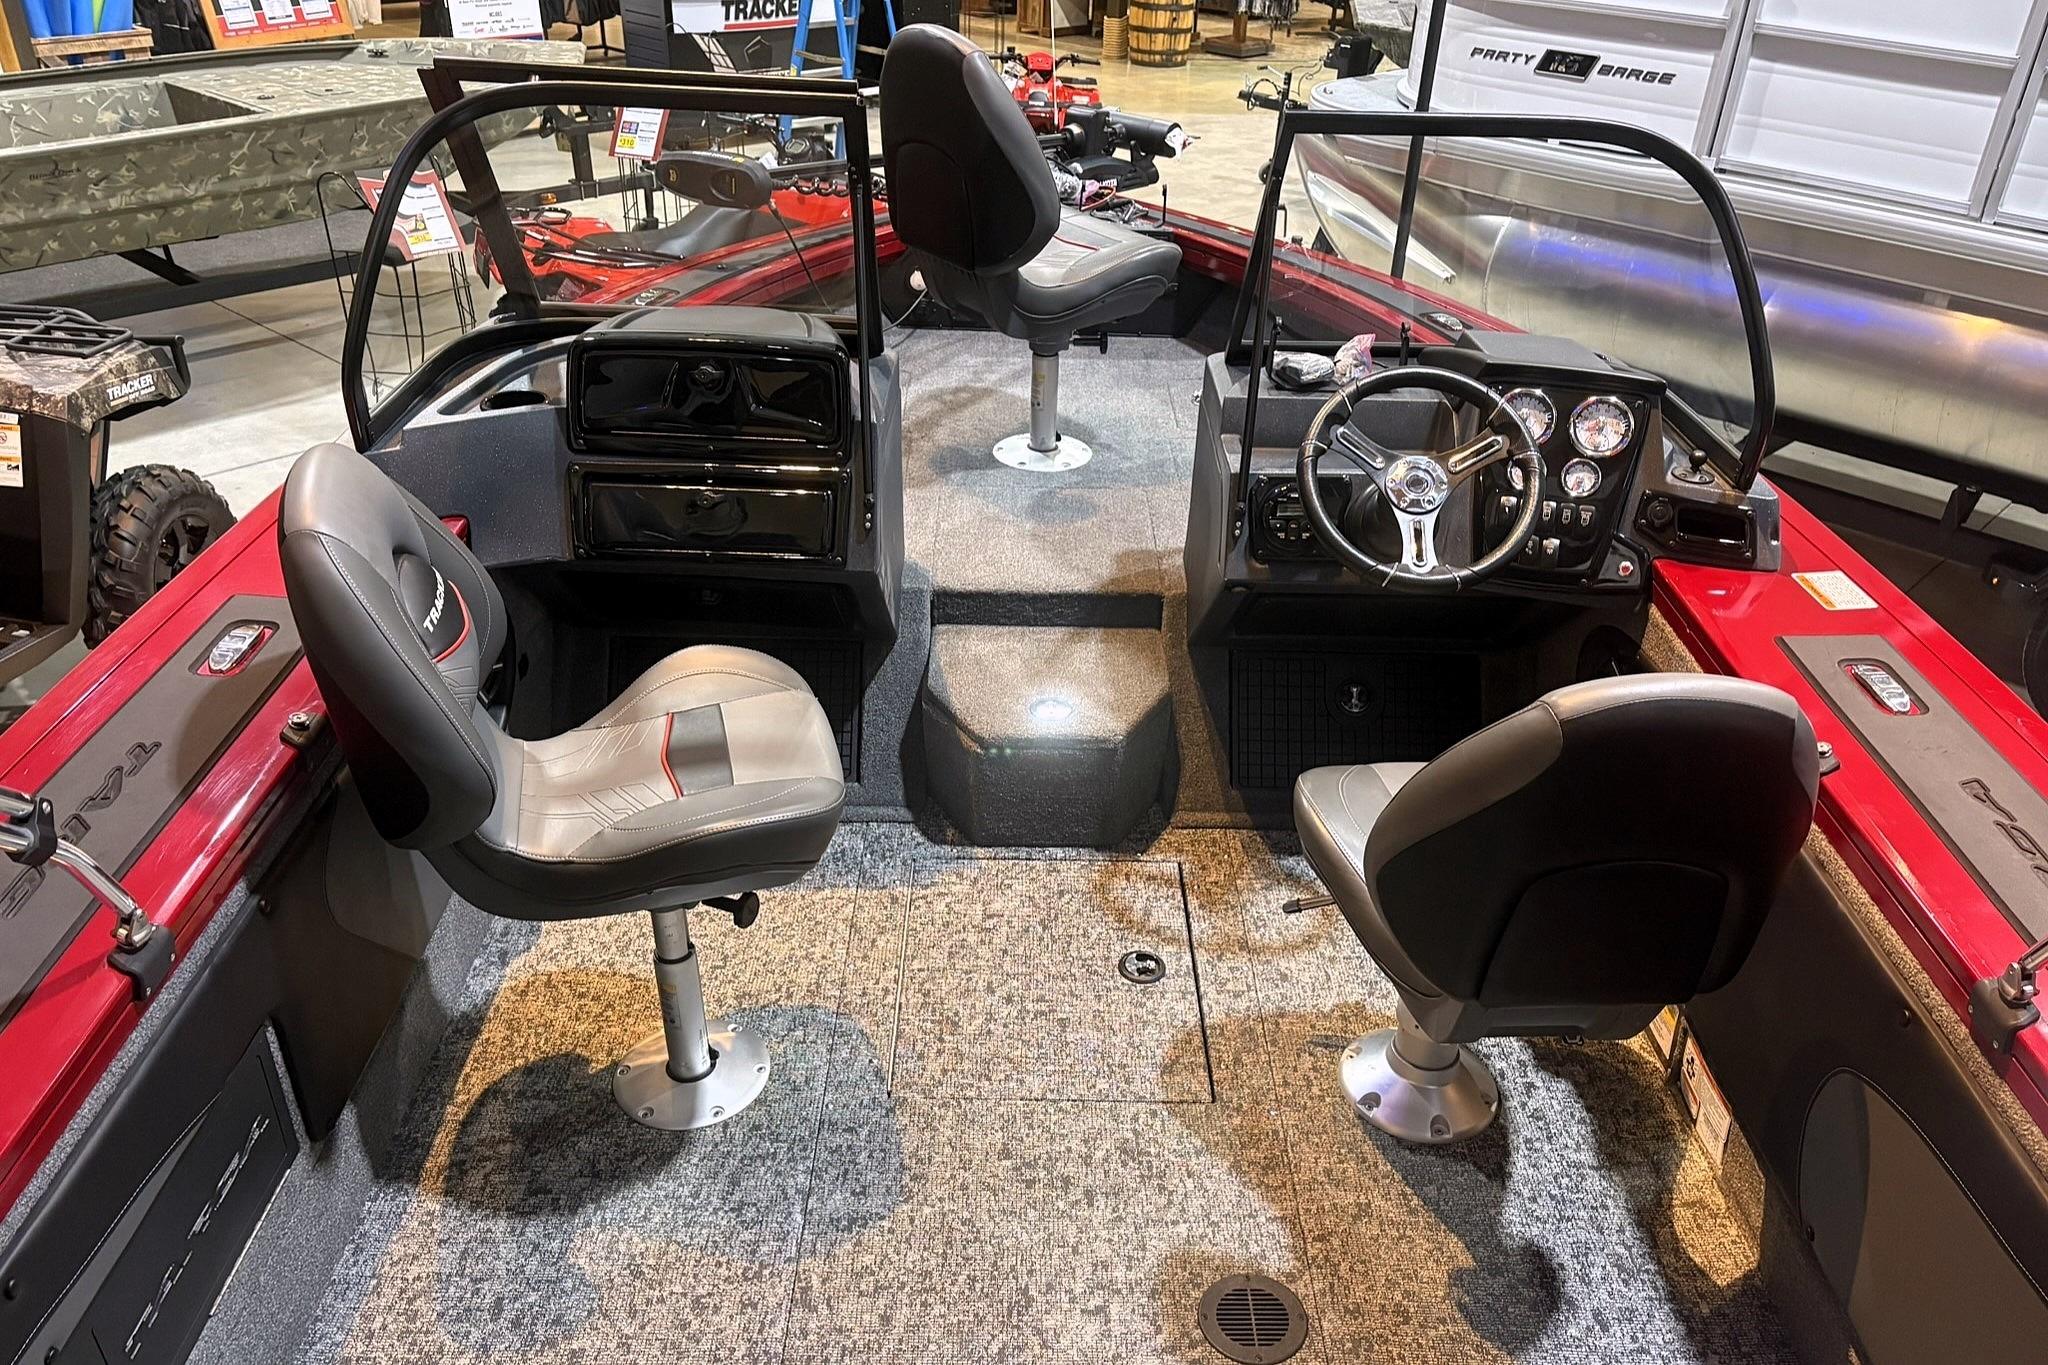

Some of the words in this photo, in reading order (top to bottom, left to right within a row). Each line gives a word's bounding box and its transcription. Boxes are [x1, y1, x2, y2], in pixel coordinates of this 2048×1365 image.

[721, 0, 799, 21] TRACKE
[1470, 46, 1536, 65] PARTY
[1597, 64, 1676, 85] BARGE
[106, 373, 154, 400] TRACKER
[422, 564, 445, 634] TRACK
